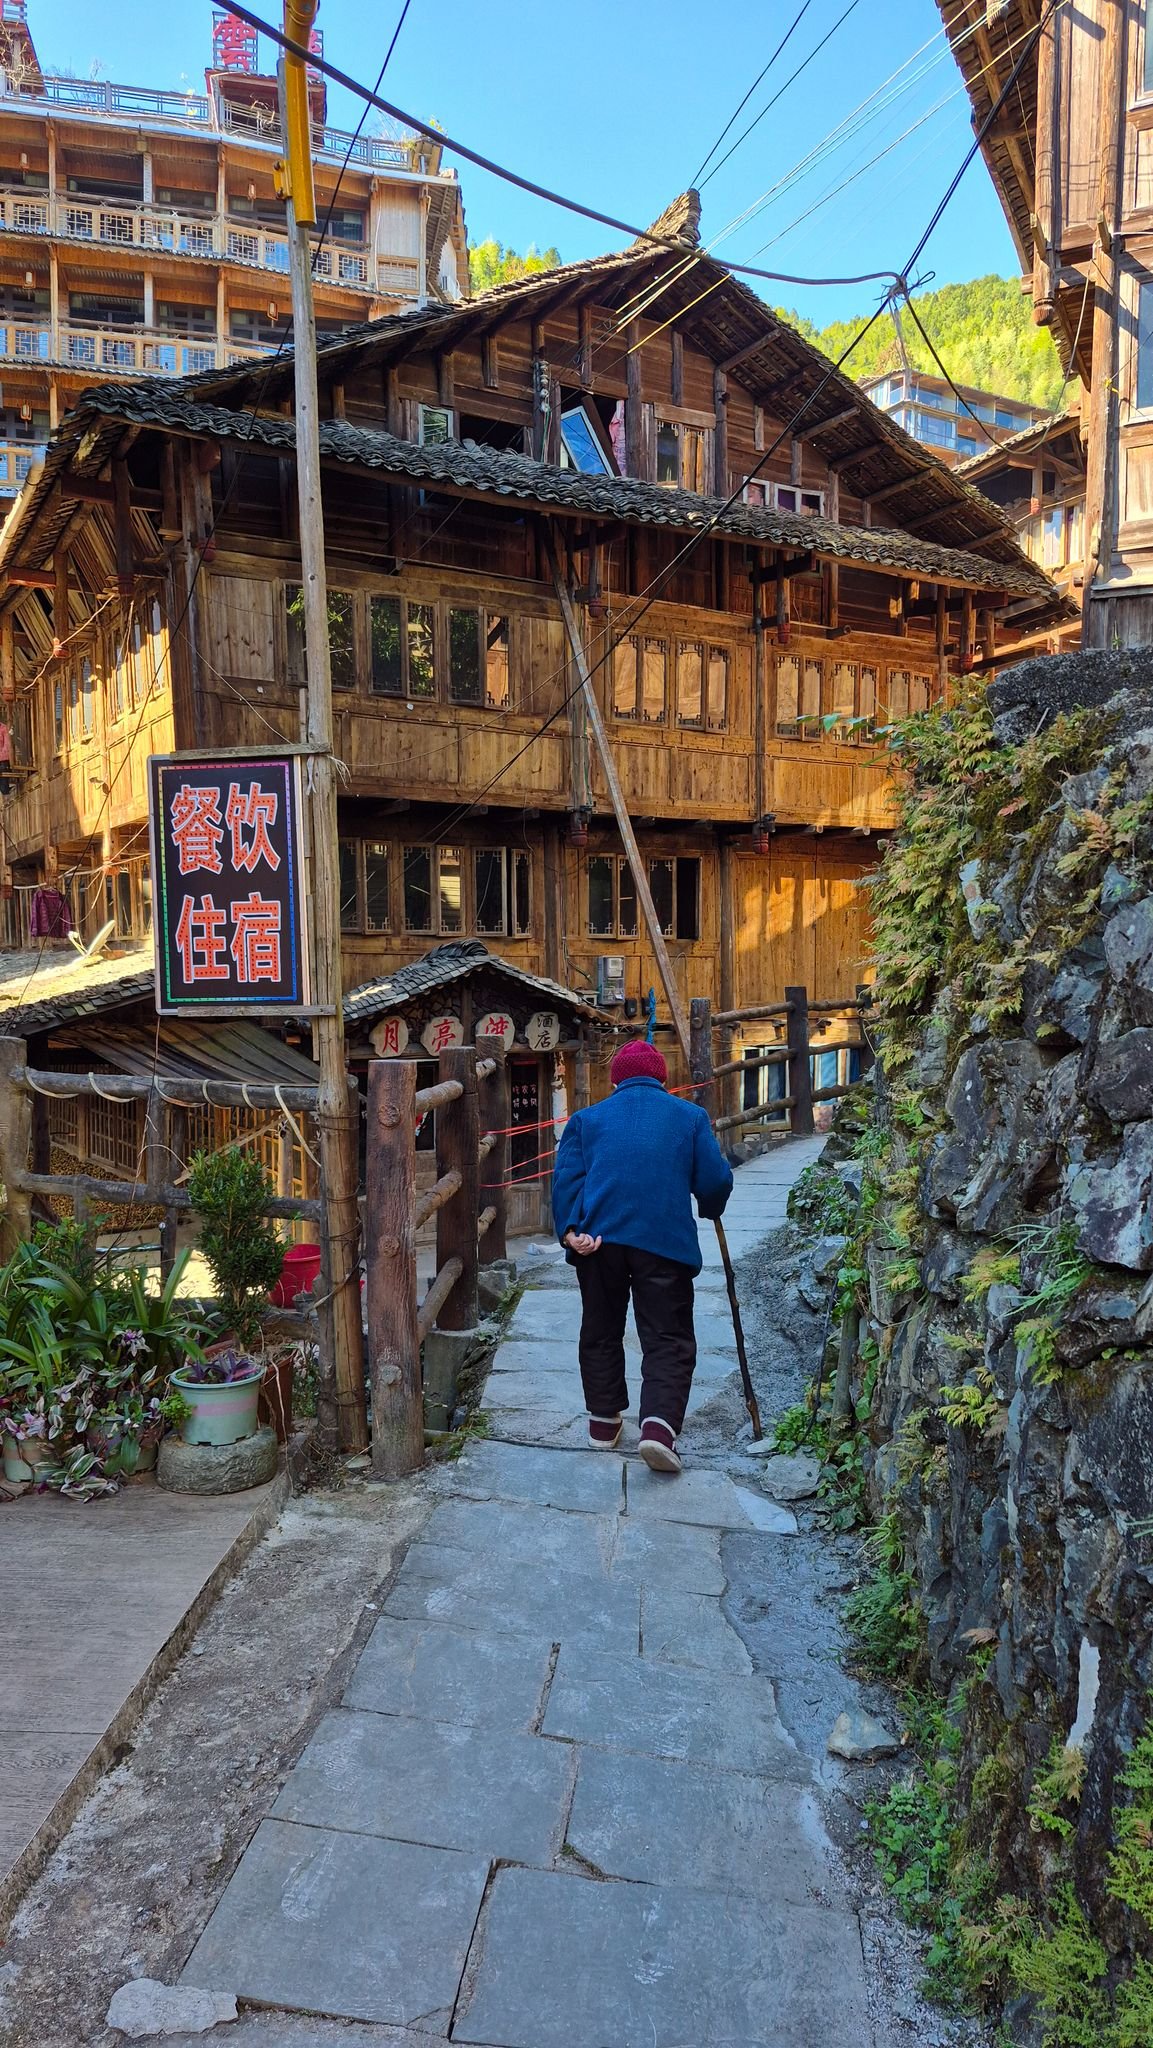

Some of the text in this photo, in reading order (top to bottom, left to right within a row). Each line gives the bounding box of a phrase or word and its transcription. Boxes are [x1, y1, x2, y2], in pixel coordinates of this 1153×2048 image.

[170, 782, 281, 875] 餐饮
[175, 892, 282, 984] 住宿
[534, 1014, 554, 1049] 酒店
